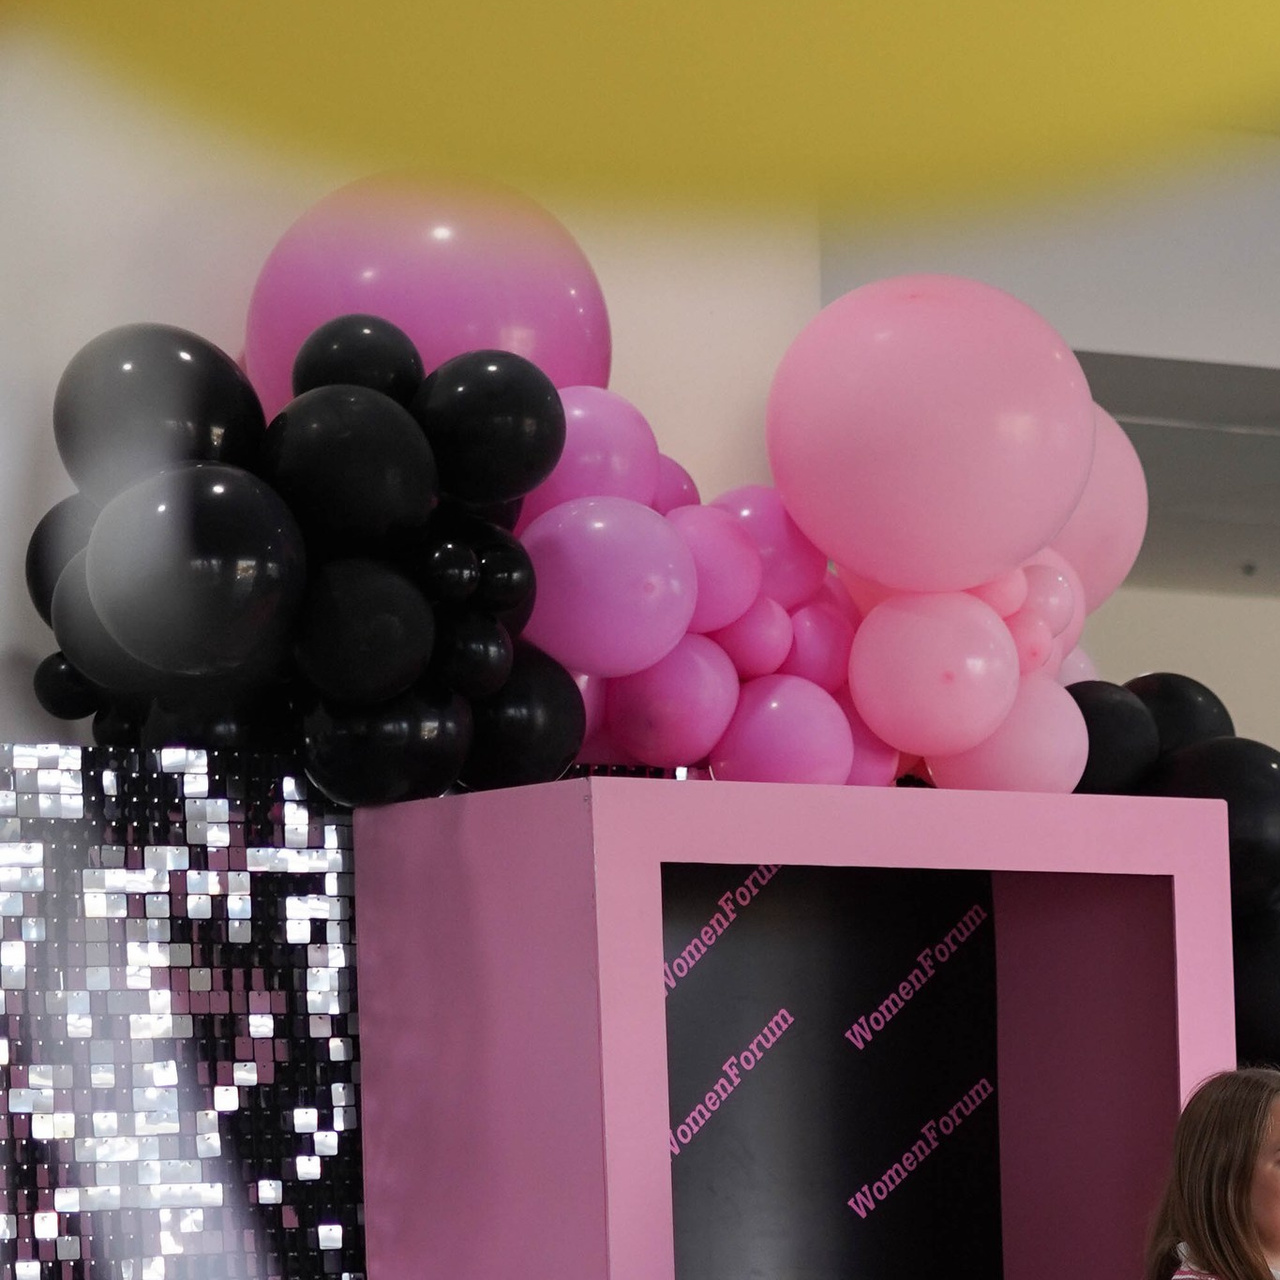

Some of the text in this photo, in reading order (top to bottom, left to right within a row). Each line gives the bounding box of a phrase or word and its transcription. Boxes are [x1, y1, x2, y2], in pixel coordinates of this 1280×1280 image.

[664, 864, 782, 997] omenForu
[844, 904, 988, 1051] WomenForum
[847, 1077, 994, 1219] WomenForum
